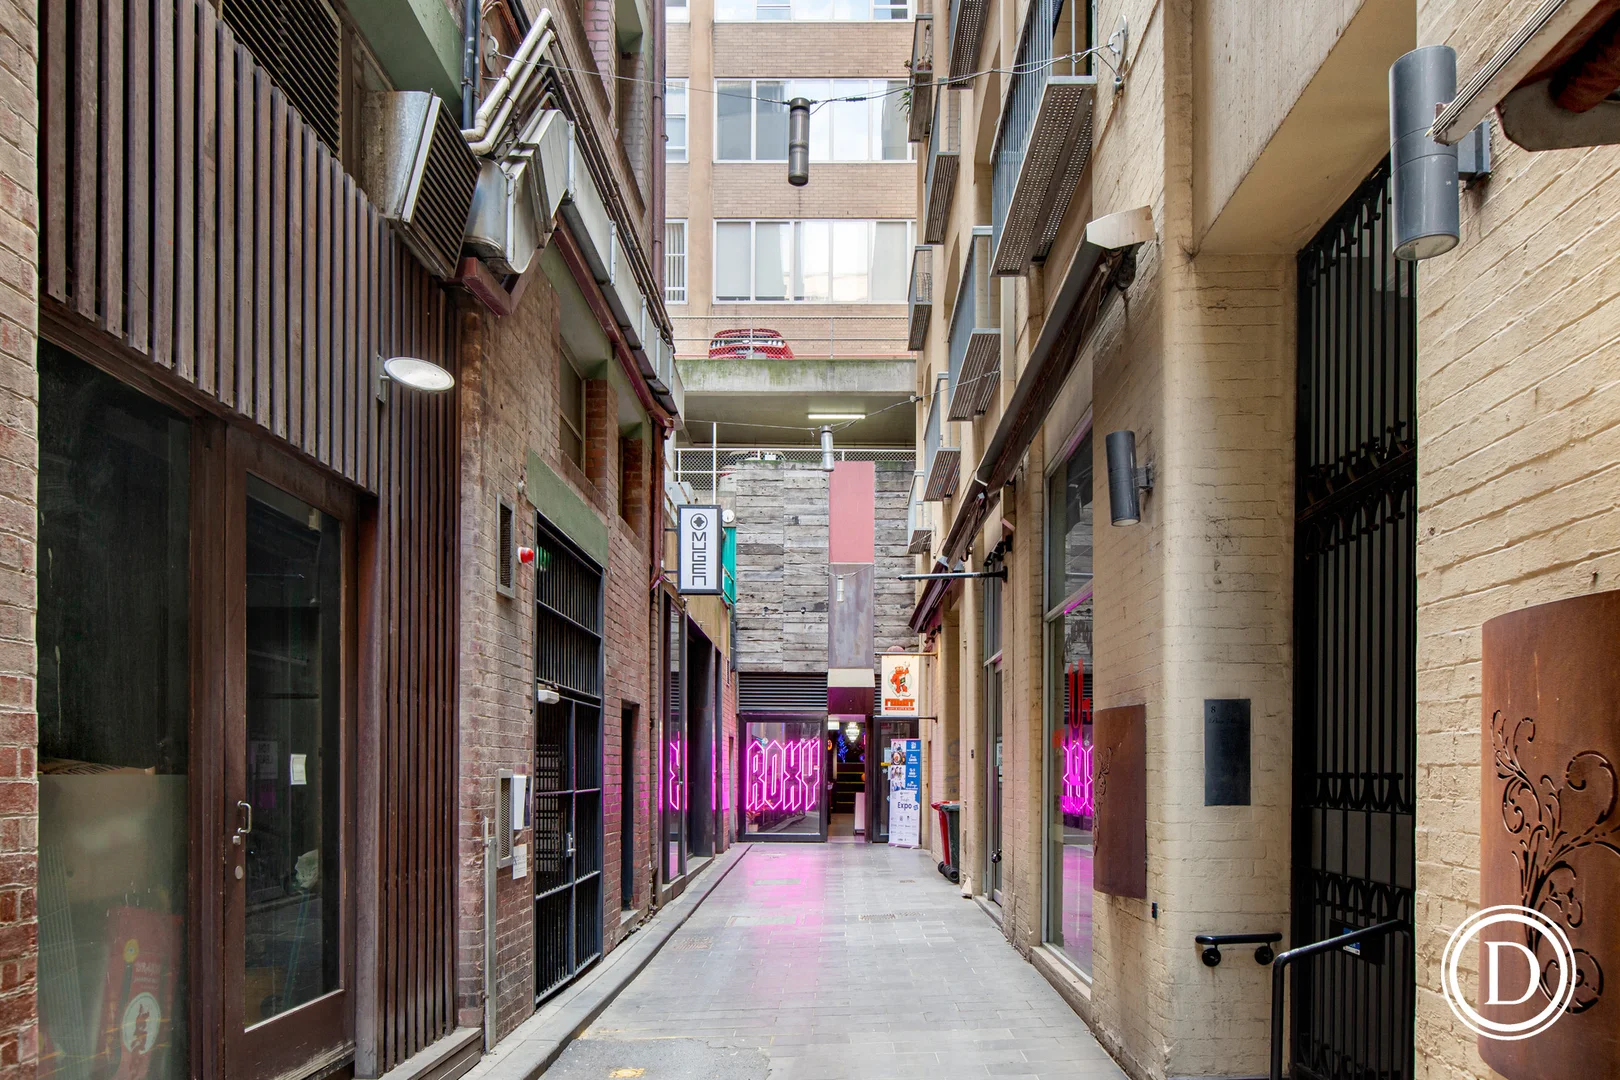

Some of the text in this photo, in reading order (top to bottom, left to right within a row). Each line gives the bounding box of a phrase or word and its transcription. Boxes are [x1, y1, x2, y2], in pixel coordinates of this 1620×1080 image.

[692, 532, 706, 586] MUGEN
[1211, 705, 1216, 713] 8
[746, 740, 820, 811] ROXY
[897, 802, 912, 811] Expo
